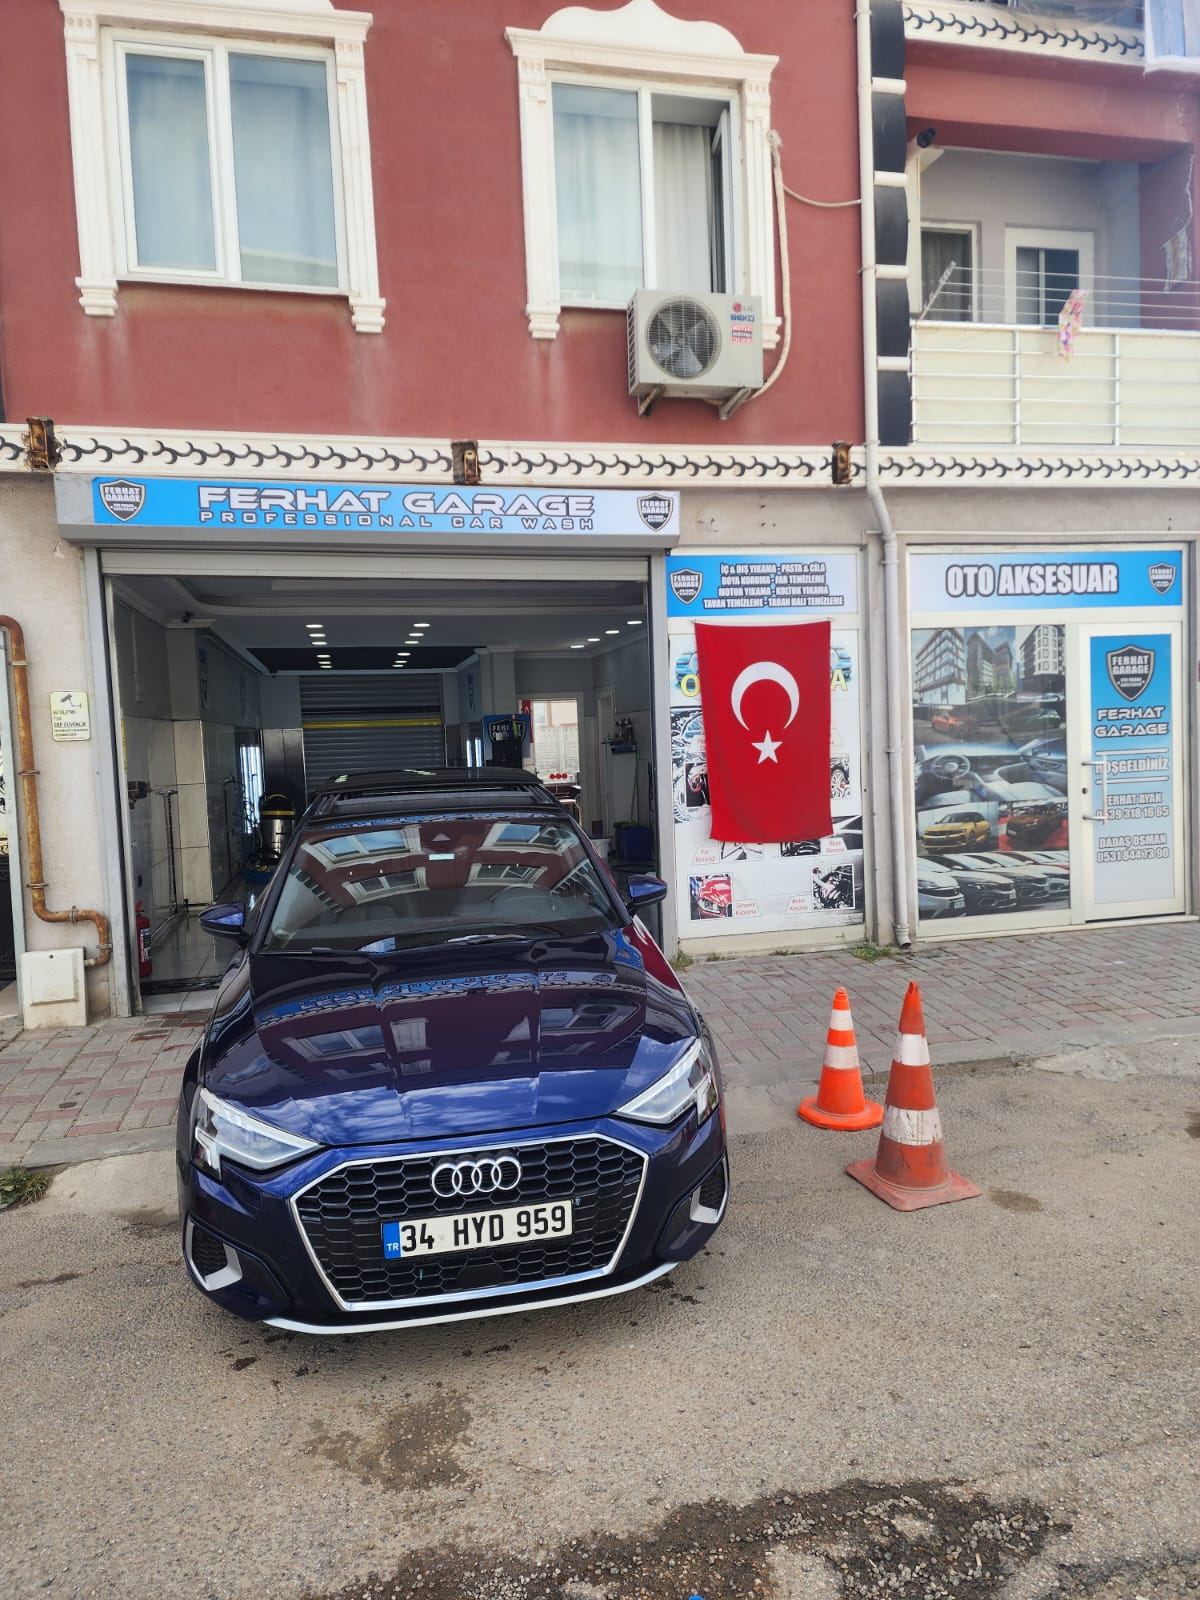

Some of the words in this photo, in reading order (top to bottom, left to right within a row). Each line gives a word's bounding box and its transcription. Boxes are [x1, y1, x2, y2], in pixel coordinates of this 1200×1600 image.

[104, 486, 140, 495] FERHAT
[198, 485, 392, 513] FERHAT
[402, 491, 595, 517] GARAGE
[199, 510, 432, 528] PROFESSIONAL
[451, 516, 503, 529] CAR
[521, 517, 594, 530] WASH
[749, 563, 777, 574] YIKAMA
[945, 564, 995, 598] OTO
[996, 562, 1119, 596] AKSESUAR
[744, 586, 772, 596] YIKAMA
[1111, 655, 1149, 666] FERHAT
[1111, 665, 1149, 675] GARAGE
[1097, 706, 1165, 721] FERHAT
[1095, 723, 1168, 738] GARAGE
[1106, 794, 1137, 806] ERHAT
[1096, 809, 1122, 820] 039
[1133, 833, 1167, 846] OSMAN
[400, 1223, 435, 1252] 34
[453, 1213, 504, 1247] HYD
[516, 1205, 566, 1238] 959
[386, 1242, 399, 1252] TR
